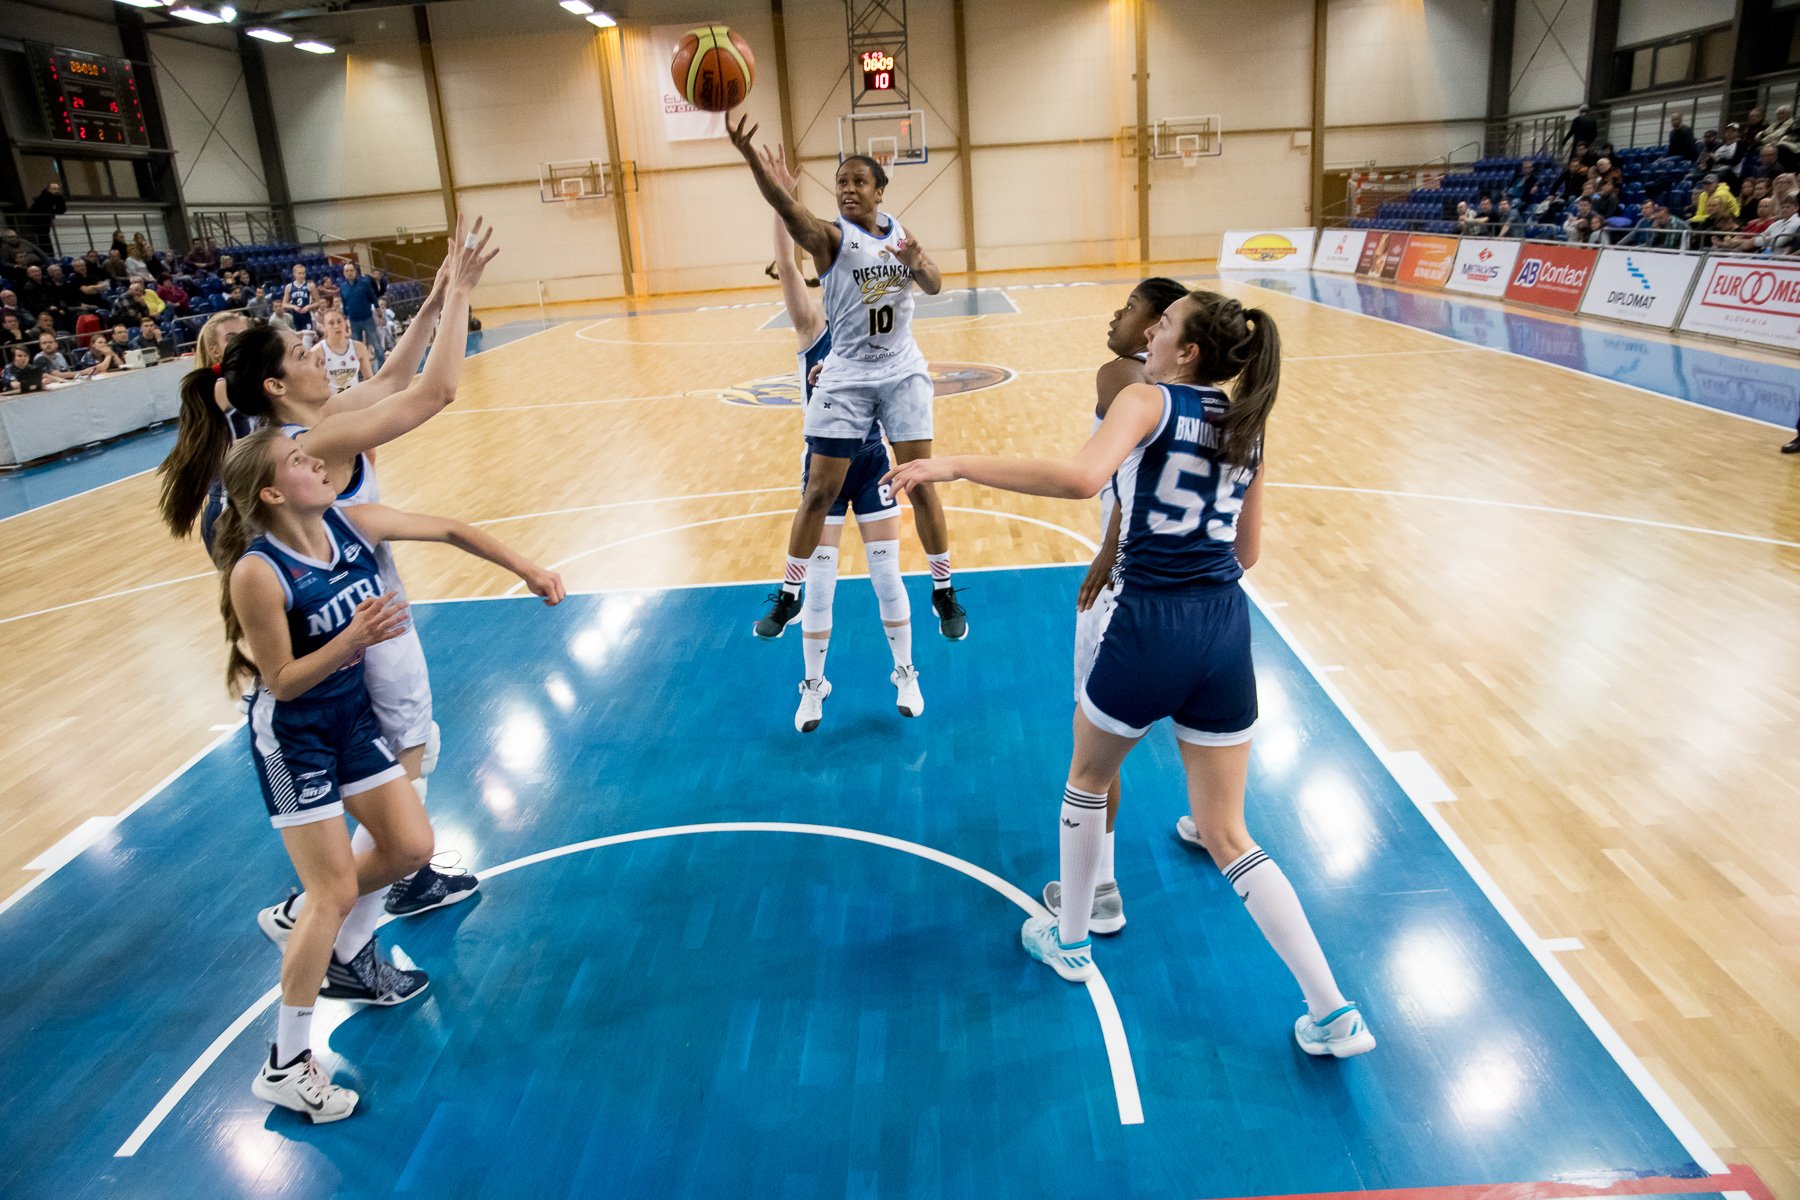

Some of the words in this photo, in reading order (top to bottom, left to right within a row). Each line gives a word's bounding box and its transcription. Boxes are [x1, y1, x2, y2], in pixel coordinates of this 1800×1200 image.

[875, 72, 889, 89] 10
[1513, 258, 1542, 288] AB
[1540, 260, 1587, 287] Contact
[1607, 291, 1656, 309] DIPLOMAT
[869, 304, 894, 337] 10
[1146, 452, 1252, 542] 55
